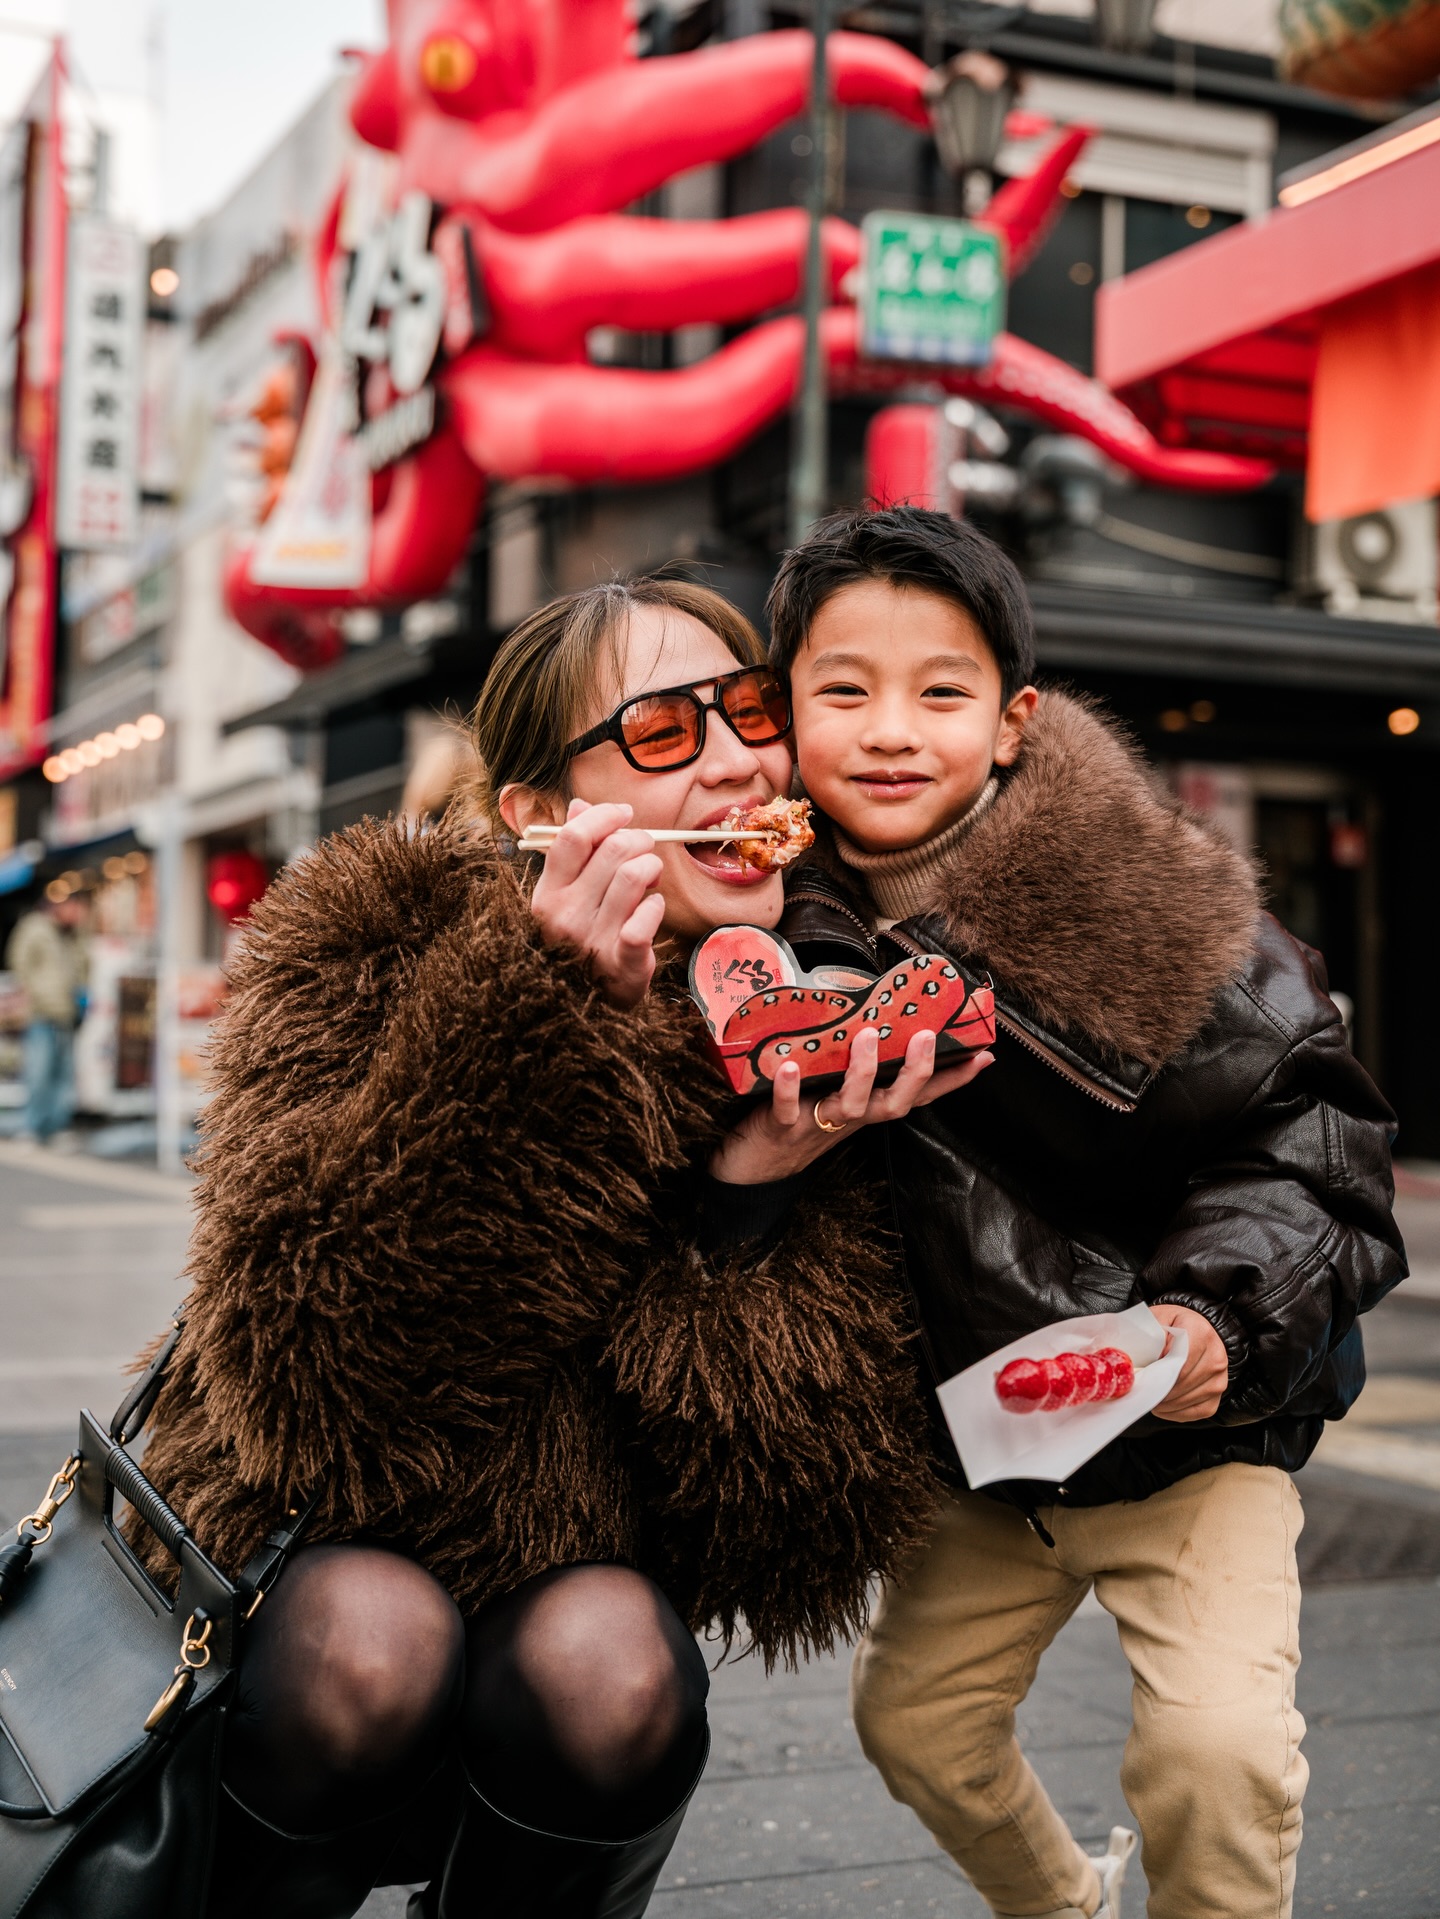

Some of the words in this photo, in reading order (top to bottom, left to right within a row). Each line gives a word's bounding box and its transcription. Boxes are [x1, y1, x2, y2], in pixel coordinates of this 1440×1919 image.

[724, 959, 773, 991] くくる
[730, 994, 752, 1003] KUK
